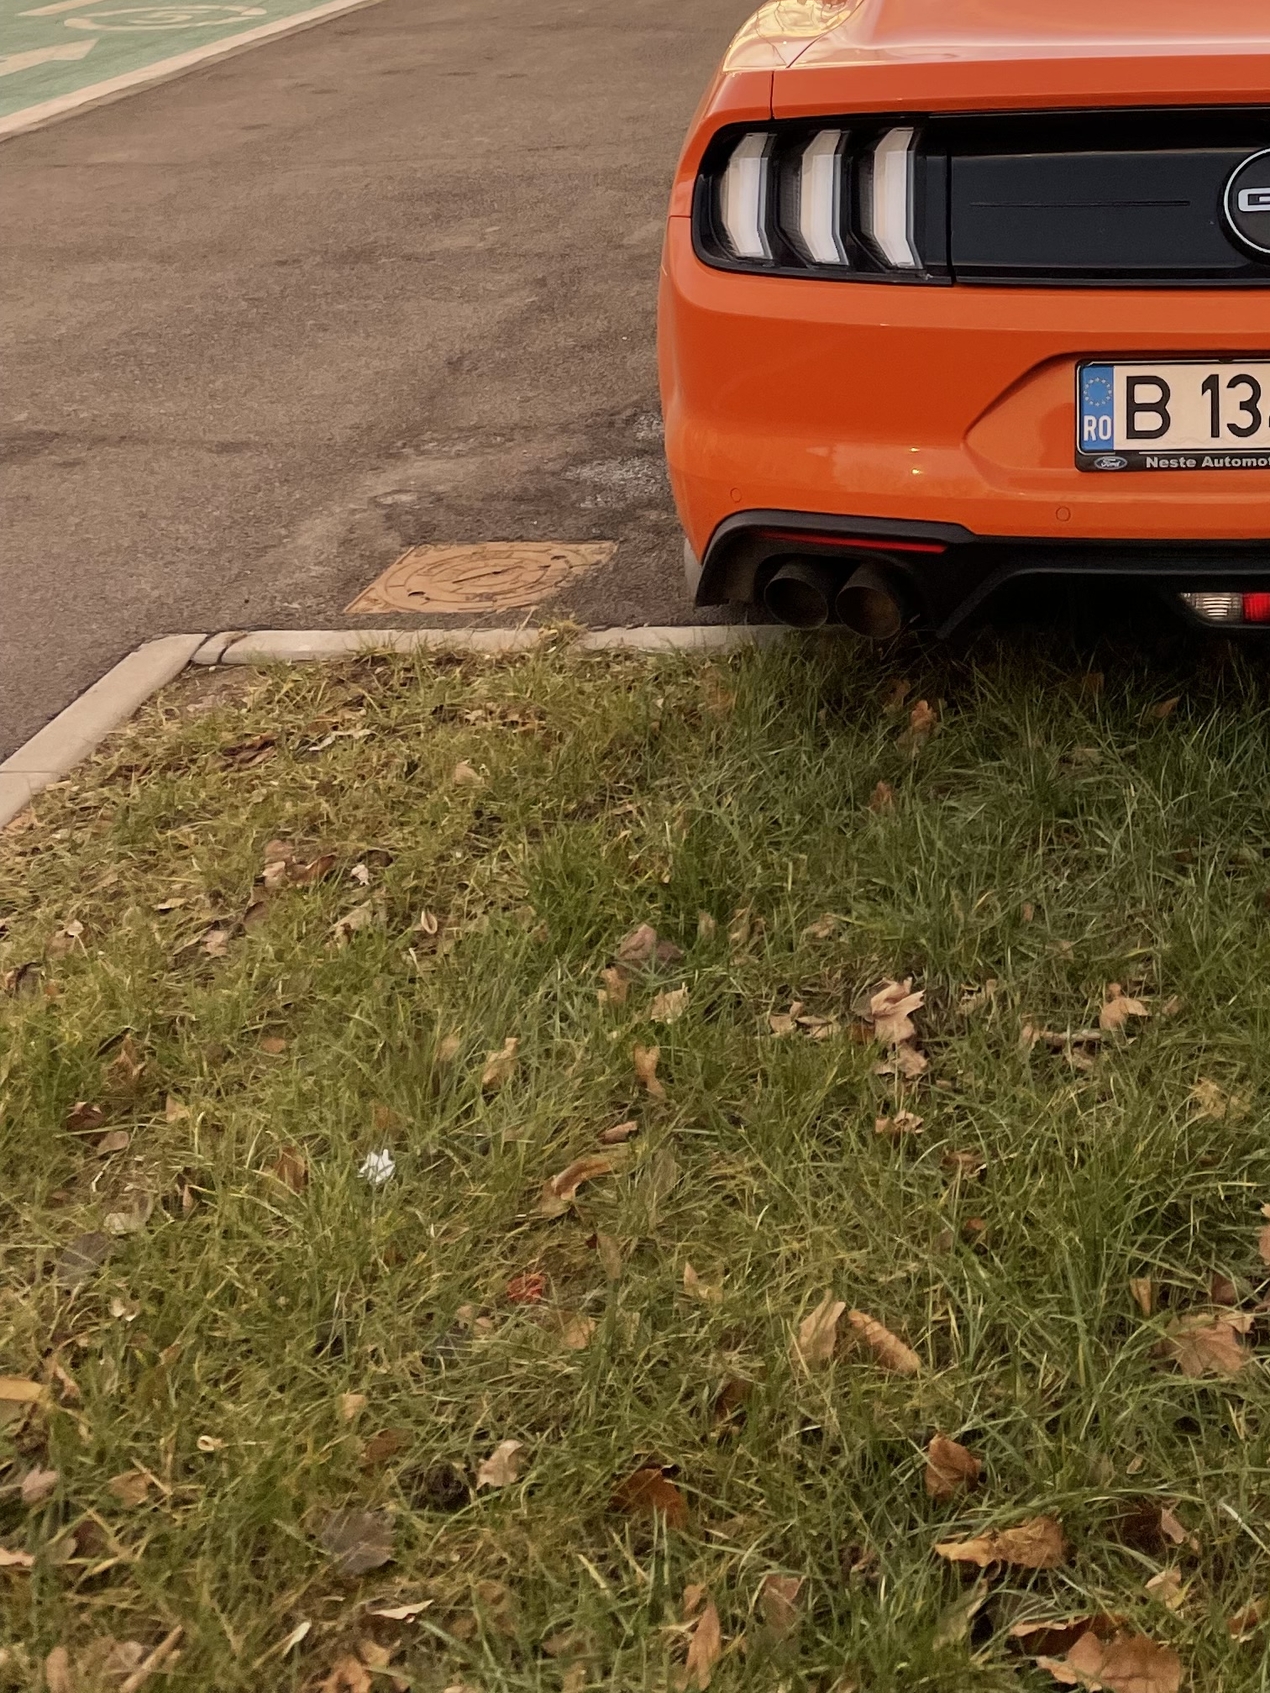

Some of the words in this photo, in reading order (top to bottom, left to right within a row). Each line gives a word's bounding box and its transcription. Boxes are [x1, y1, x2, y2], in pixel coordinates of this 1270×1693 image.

[1125, 375, 1171, 440] B
[1083, 415, 1112, 441] RO
[1099, 457, 1123, 469] Ford
[1146, 456, 1197, 468] Neste
